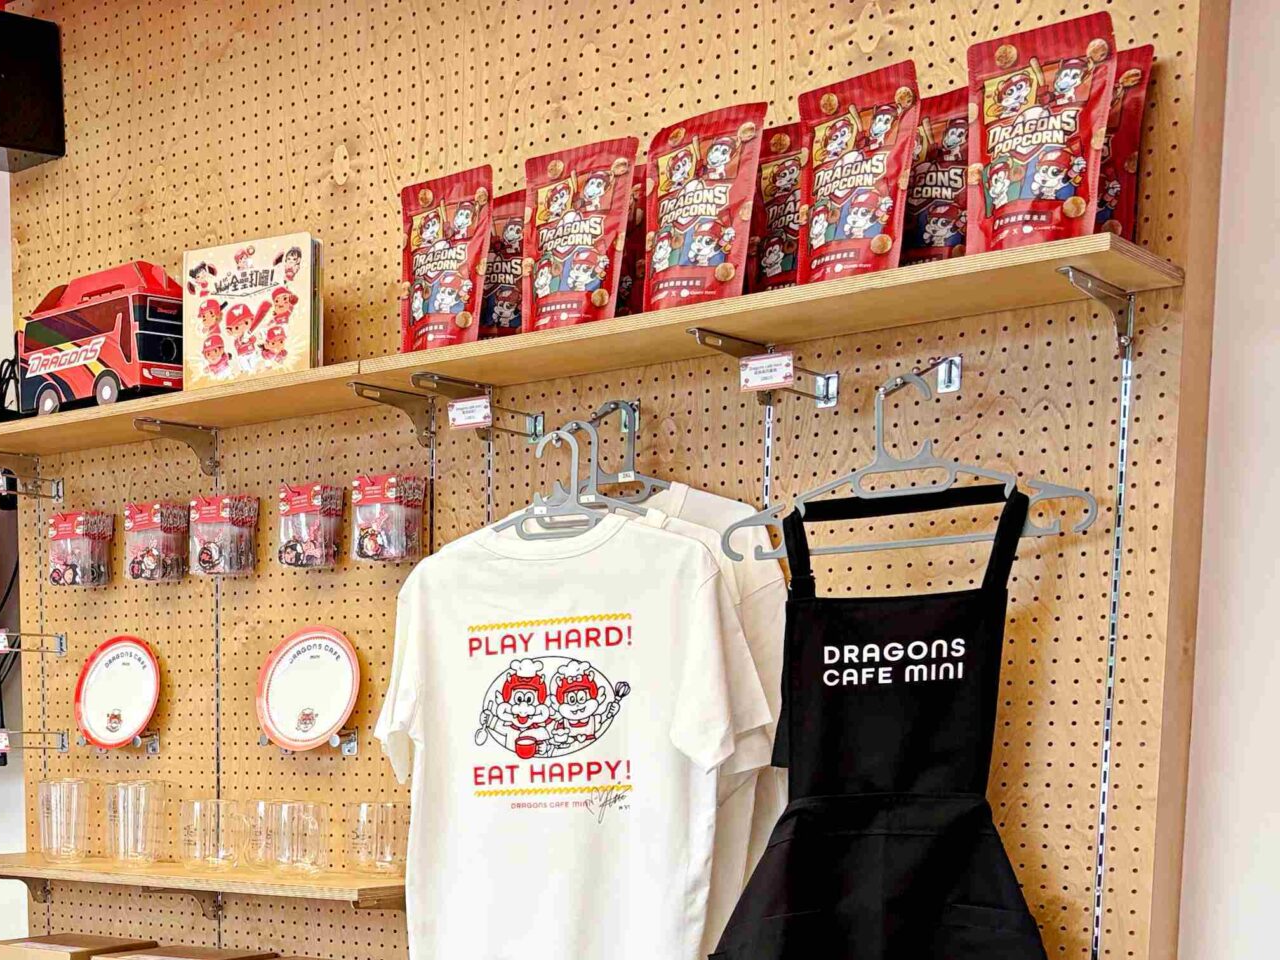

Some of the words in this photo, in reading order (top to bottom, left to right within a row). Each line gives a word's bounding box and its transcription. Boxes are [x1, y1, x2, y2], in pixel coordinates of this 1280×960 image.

[987, 109, 1080, 150] DRAGONS
[994, 130, 1064, 156] POPCORN
[813, 153, 886, 192] DRAGONS
[817, 175, 875, 199] POPCORN
[913, 186, 955, 200] CORN
[658, 185, 730, 218] DRAGONS
[661, 203, 717, 227] POPCORN
[538, 217, 603, 248] DRAGONS
[542, 233, 595, 252] POPCORN
[412, 244, 468, 270] DRAGONS
[415, 258, 459, 278] POPCORN
[484, 274, 516, 286] CORN
[29, 339, 103, 374] DRAGONS
[324, 644, 342, 662] CAFE
[468, 632, 535, 657] PLAY
[545, 625, 632, 651] HARD!
[823, 638, 966, 664] DRAGONS
[822, 666, 893, 687] CAFE
[473, 764, 520, 786] EAT
[529, 760, 632, 784] HAPPY!
[510, 801, 548, 810] DRAGONS
[549, 800, 570, 809] CAFE
